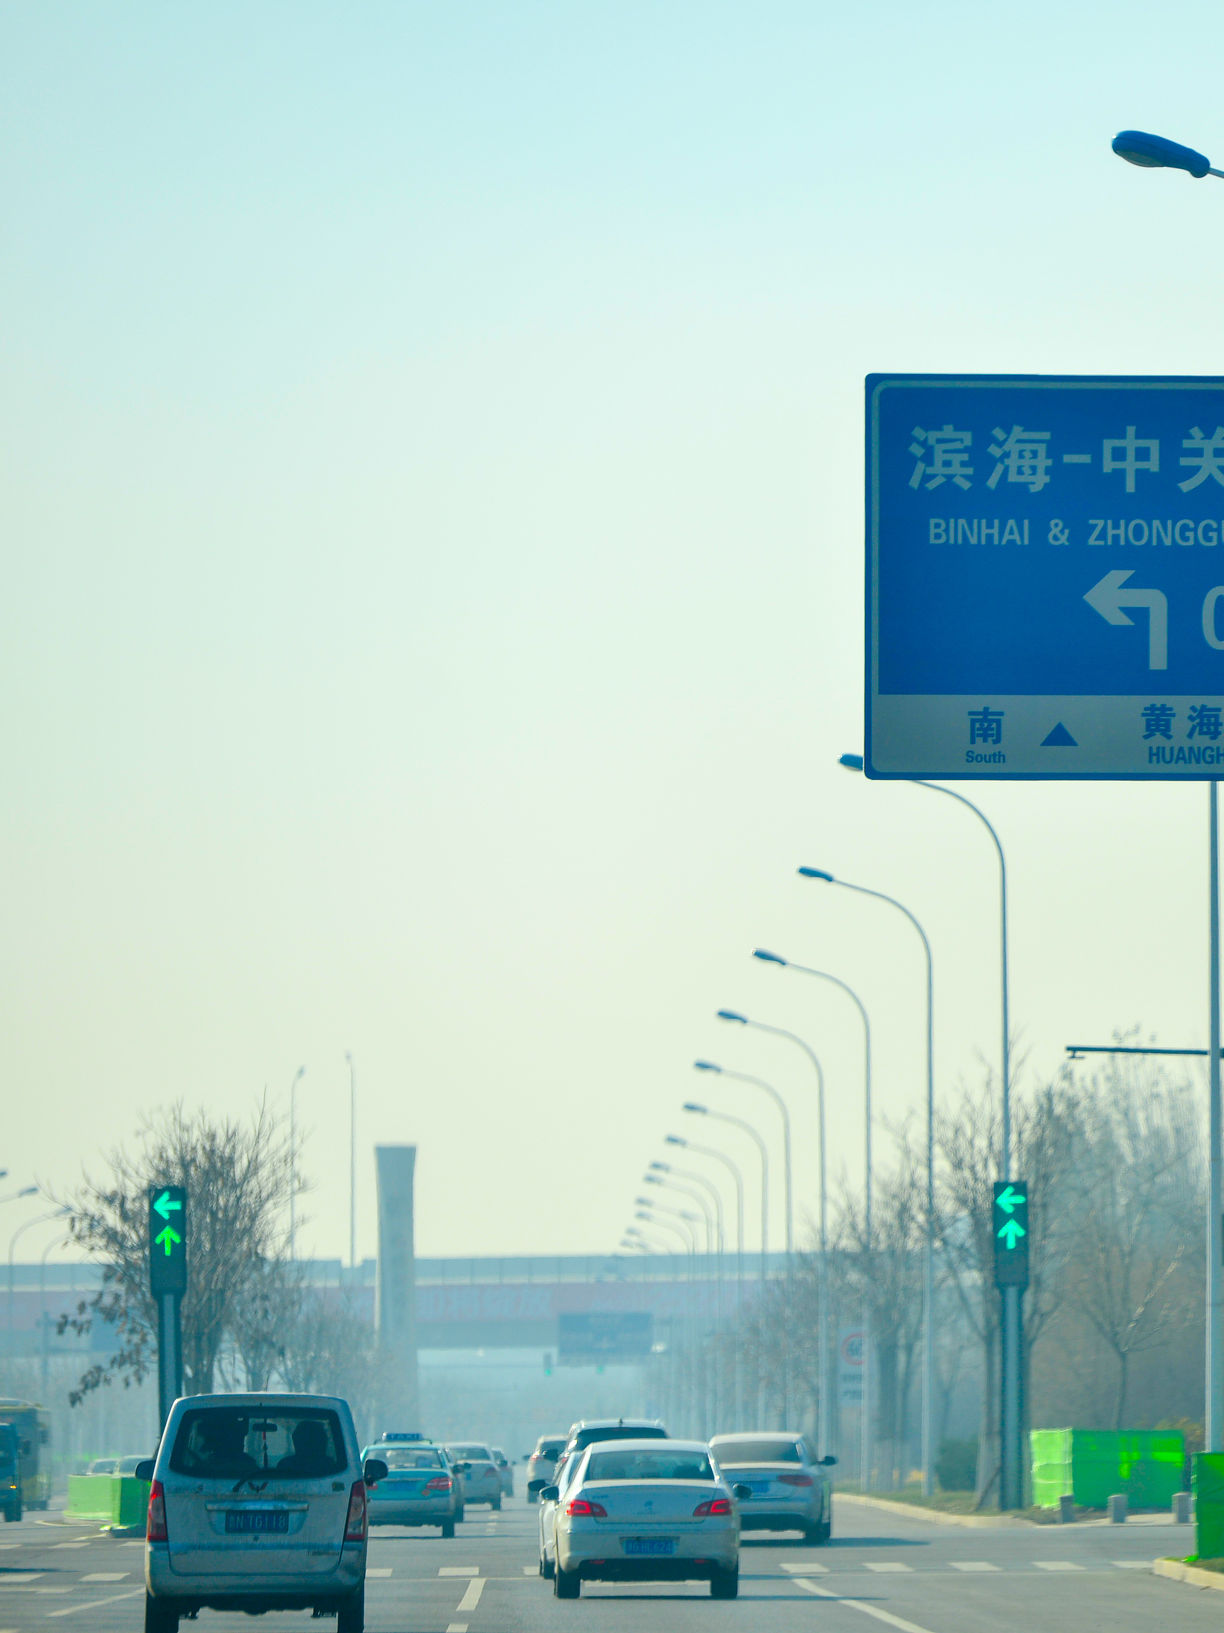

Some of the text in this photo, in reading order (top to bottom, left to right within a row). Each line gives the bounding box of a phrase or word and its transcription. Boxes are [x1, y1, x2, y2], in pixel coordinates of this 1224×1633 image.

[929, 518, 1030, 546] BINHAI
[1047, 518, 1070, 546] &
[967, 706, 1005, 745] 南
[965, 749, 1006, 764] South
